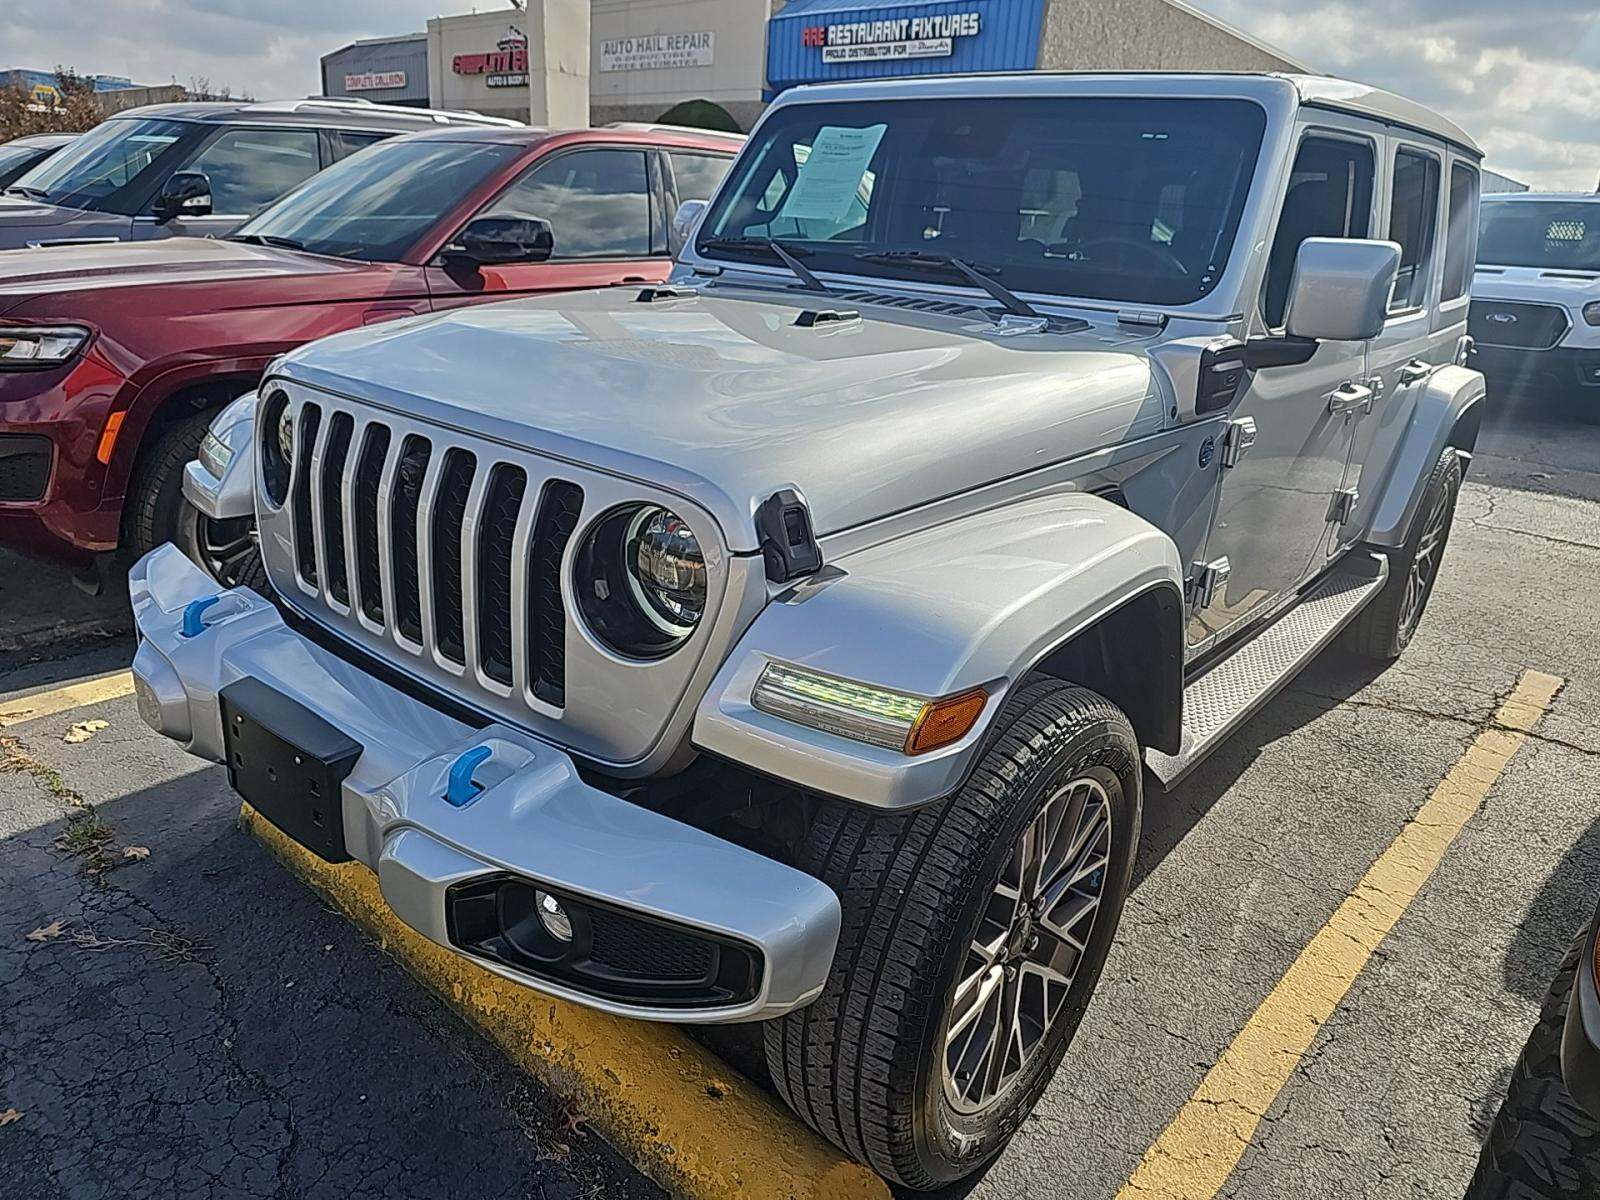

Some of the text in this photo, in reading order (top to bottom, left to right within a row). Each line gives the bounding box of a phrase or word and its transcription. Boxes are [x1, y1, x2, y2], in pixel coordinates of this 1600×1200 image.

[827, 19, 910, 45] RESTAURANT
[911, 12, 980, 39] FIXTURES
[603, 33, 711, 56] AUTO HAIL REPAIR
[825, 48, 846, 60] PROUD
[848, 45, 891, 58] DISTRIBUTOR
[893, 44, 907, 56] FOR
